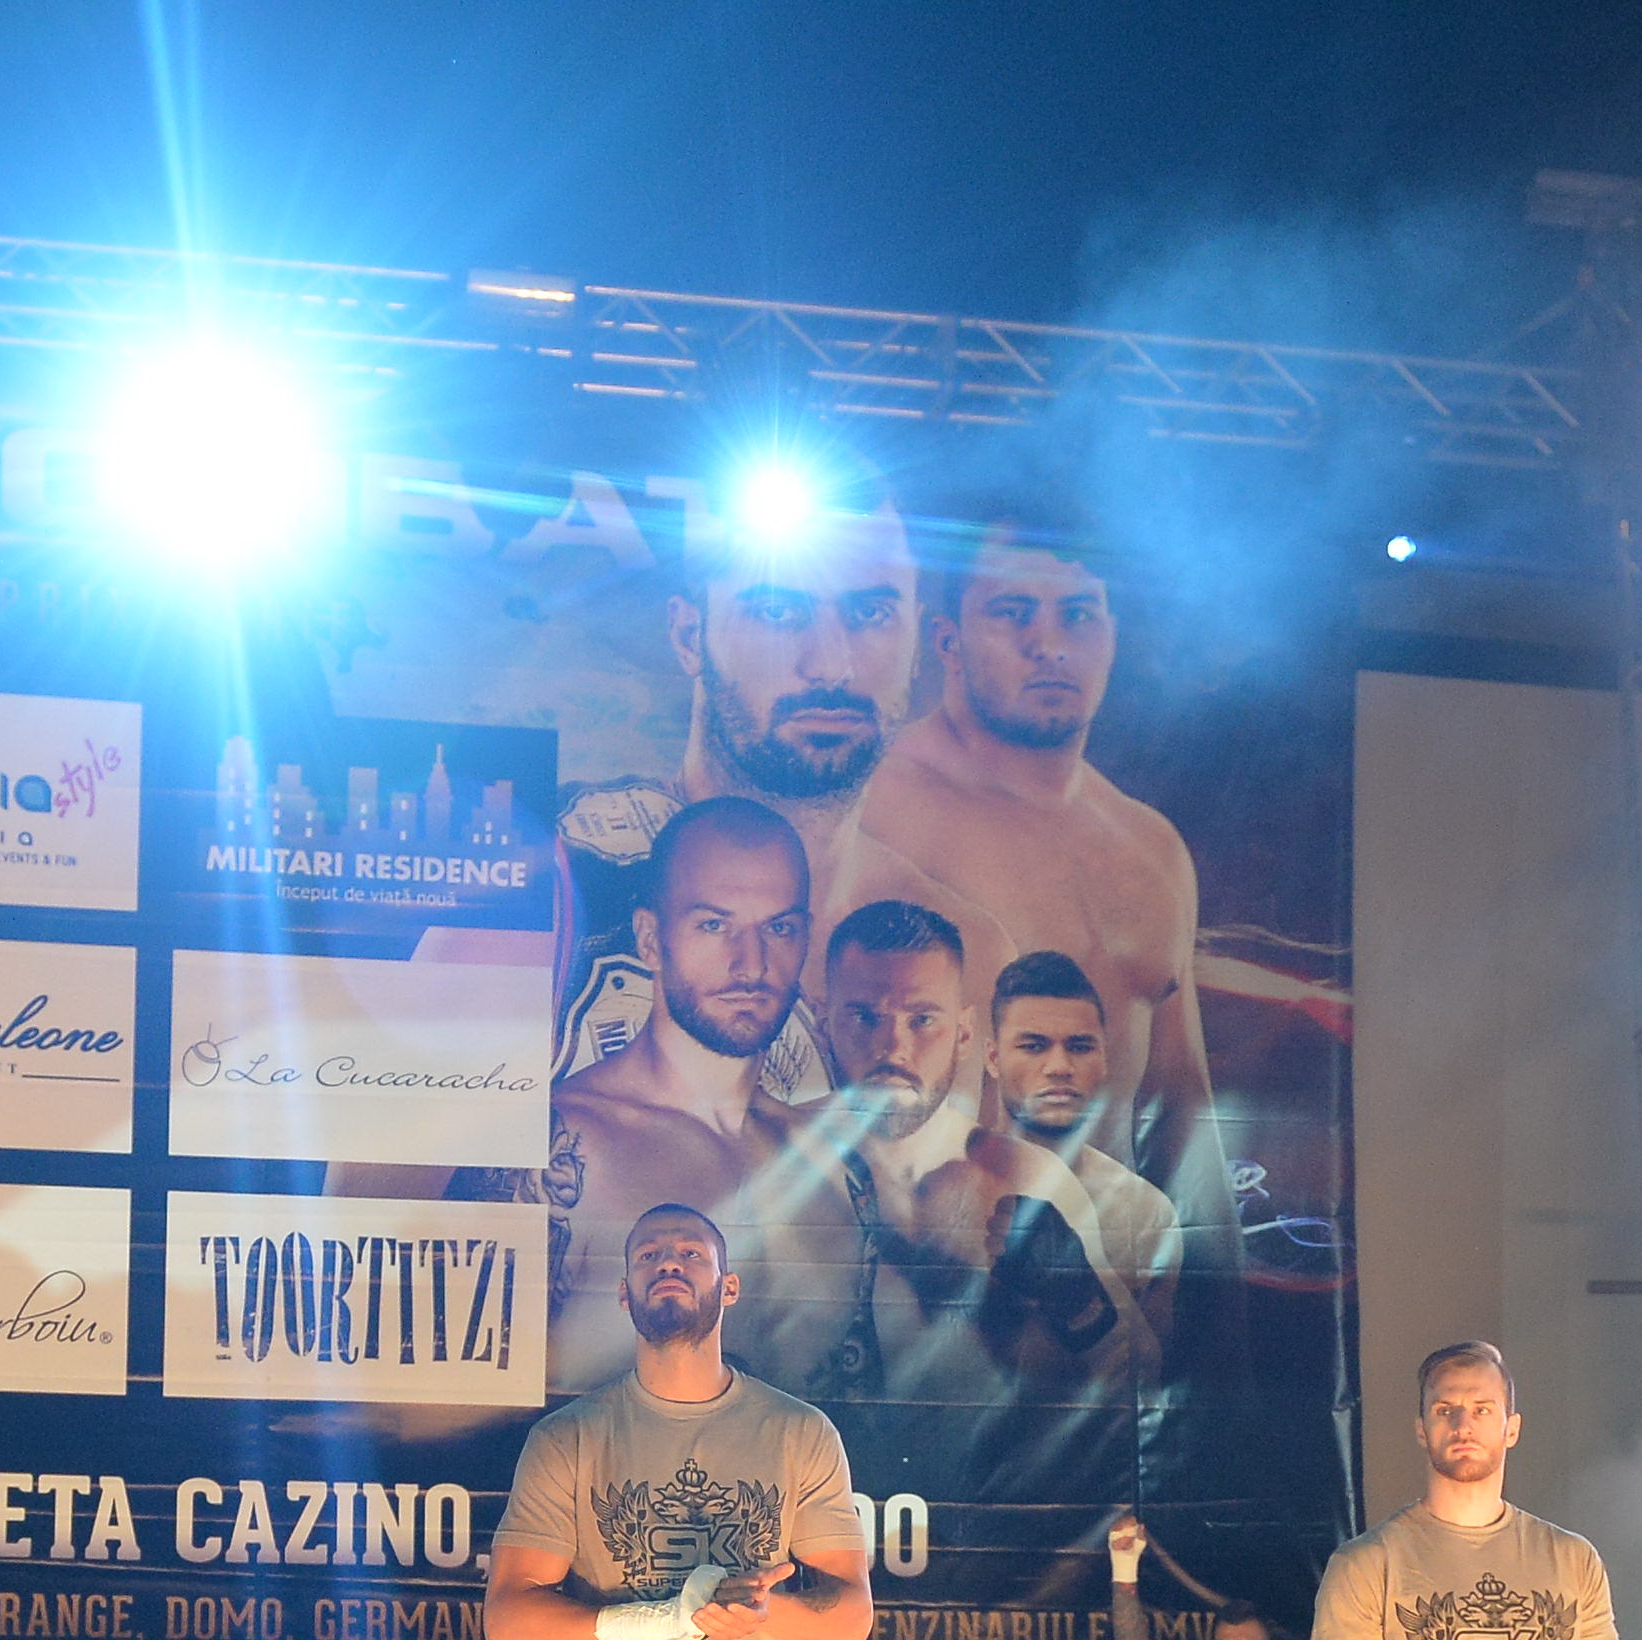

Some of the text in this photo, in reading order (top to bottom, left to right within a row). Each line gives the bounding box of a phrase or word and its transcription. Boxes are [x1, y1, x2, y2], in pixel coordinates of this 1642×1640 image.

[207, 845, 527, 889] MILITARI RESIDENCE
[344, 887, 365, 902] de
[225, 1053, 539, 1093] La Cucaracha
